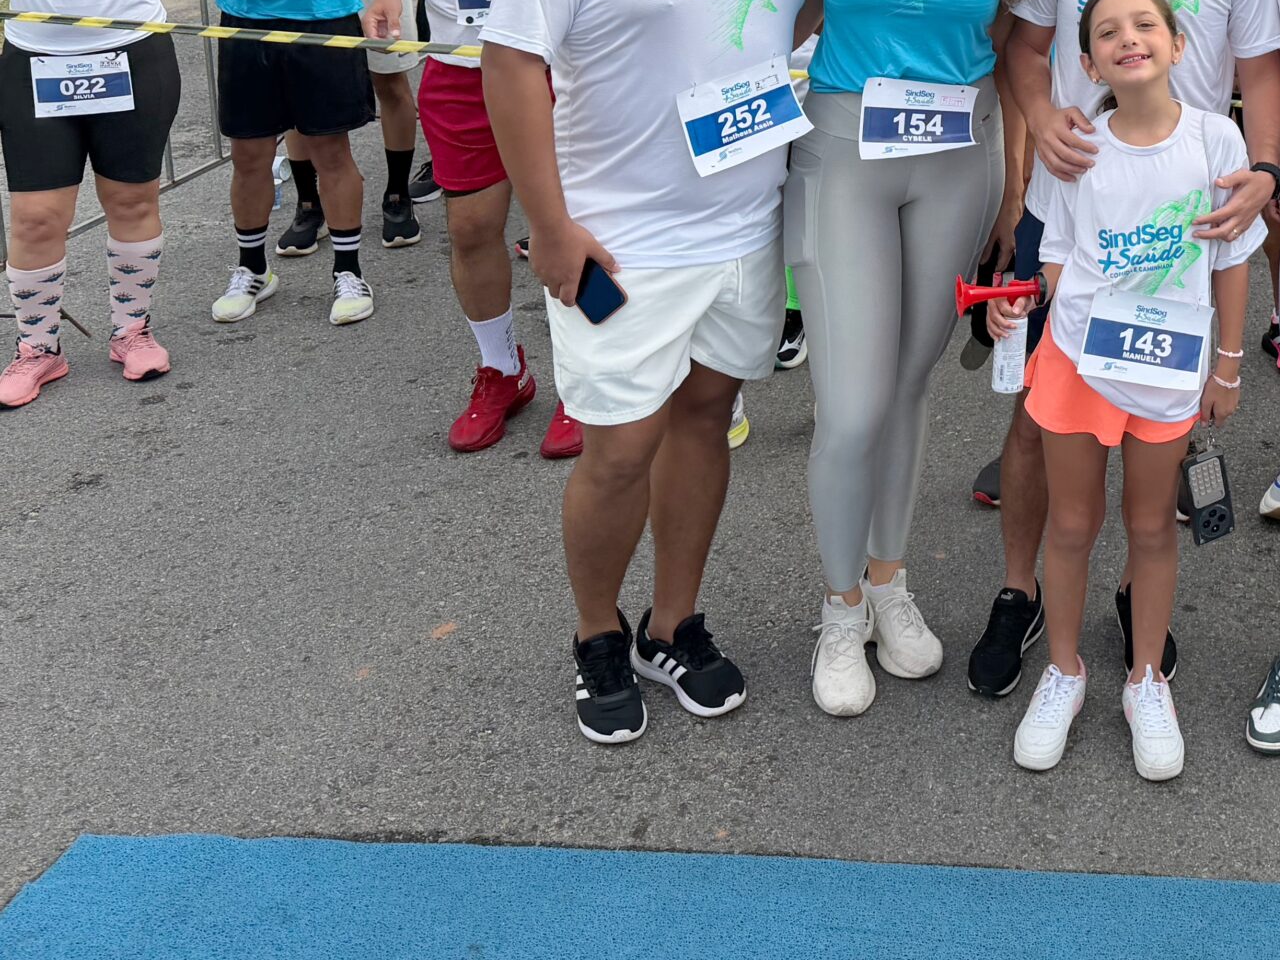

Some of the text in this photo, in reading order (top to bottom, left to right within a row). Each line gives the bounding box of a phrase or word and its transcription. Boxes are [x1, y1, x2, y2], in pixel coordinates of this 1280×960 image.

[60, 77, 106, 96] 022
[721, 80, 750, 96] SindSeg
[905, 88, 935, 100] SindSeg
[717, 98, 772, 138] 252
[893, 111, 944, 136] 154
[721, 119, 774, 145] Matheus Assis
[902, 134, 933, 143] CYBELE
[1098, 223, 1183, 250] SindSeg
[1138, 263, 1174, 273] CAMINHADA
[1135, 304, 1168, 318] SindSeg
[1119, 327, 1173, 357] 143
[1122, 351, 1162, 364] MANUELA
